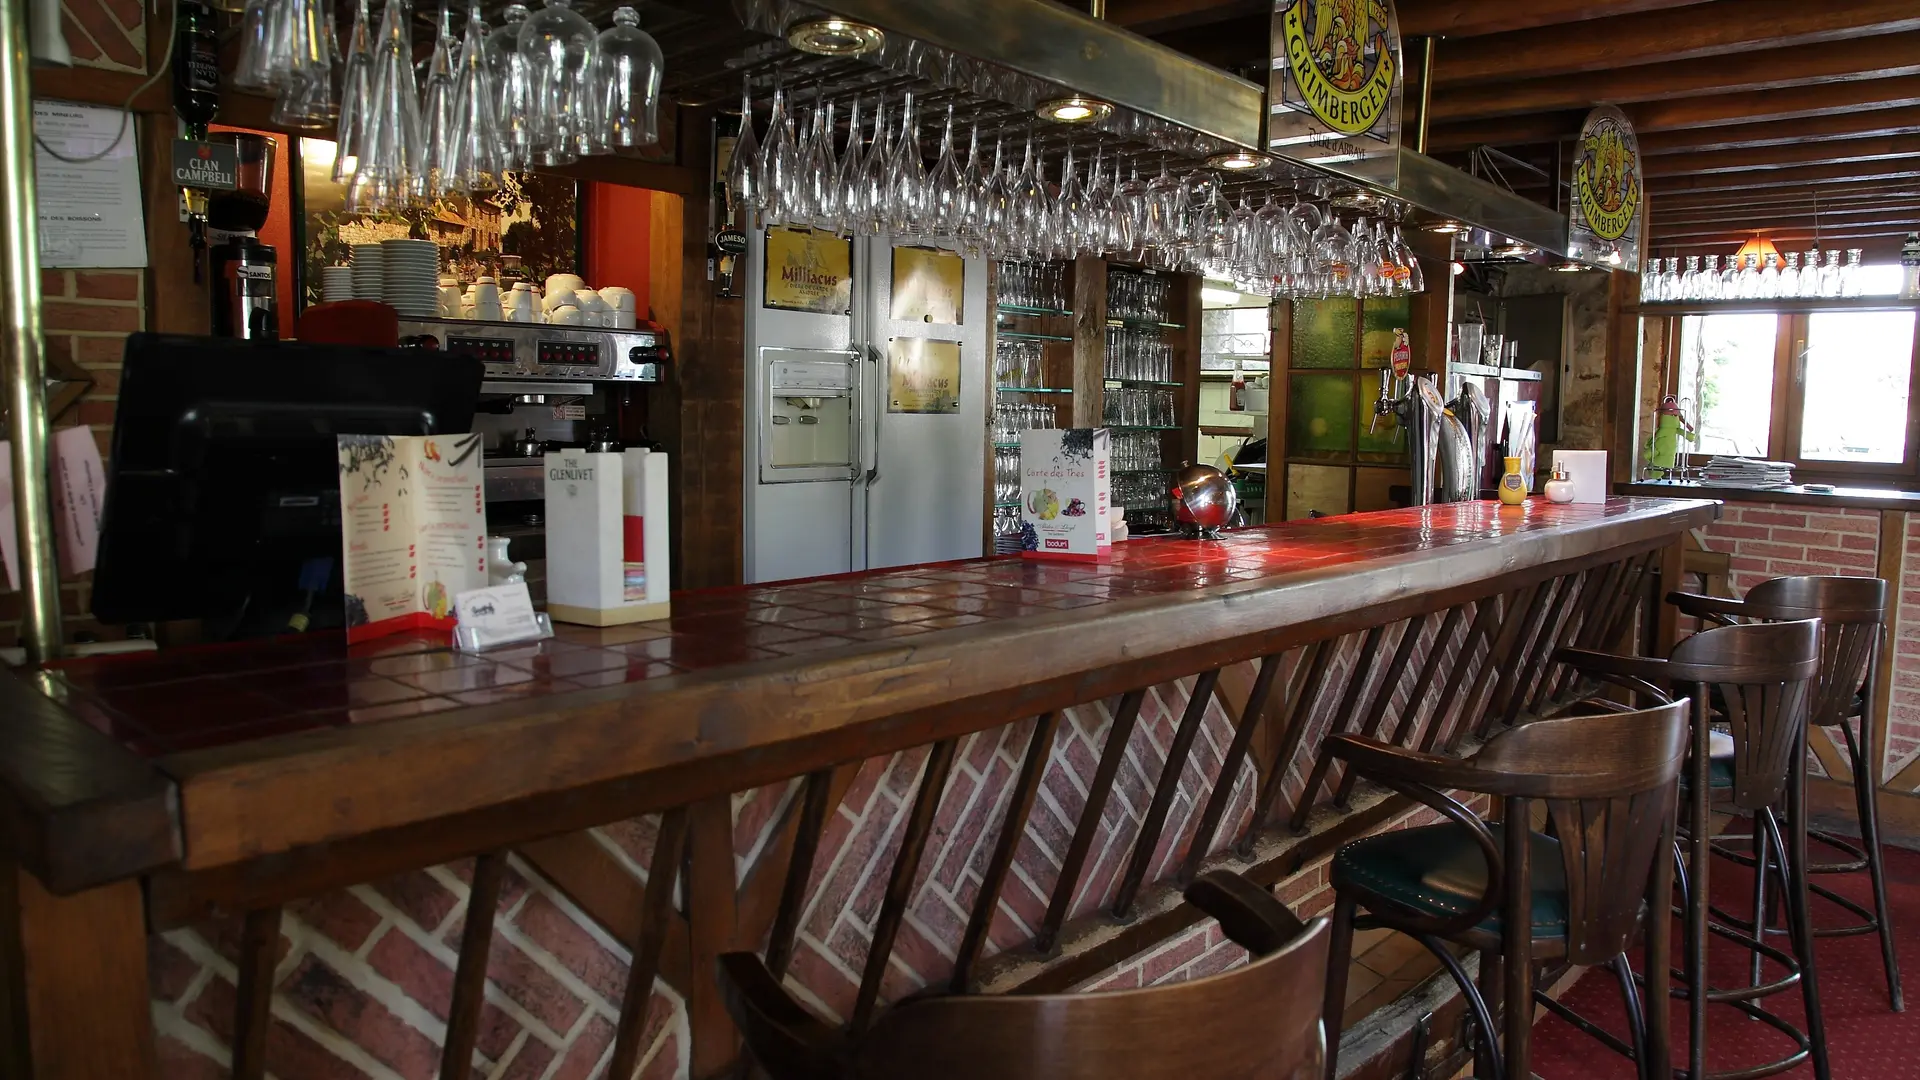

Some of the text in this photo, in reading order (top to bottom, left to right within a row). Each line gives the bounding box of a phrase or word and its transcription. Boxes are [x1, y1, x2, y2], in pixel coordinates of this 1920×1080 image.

[1290, 35, 1388, 124] GRIMBERGEN
[189, 158, 219, 171] CLAN
[176, 168, 233, 185] CAMPBELL
[1581, 181, 1634, 234] GRIMBERGEN
[720, 234, 746, 244] JAMESO
[249, 271, 271, 279] SANTOS
[782, 265, 837, 287] Milliacus
[564, 459, 578, 468] THE
[549, 468, 594, 481] GLENLIVET
[1026, 468, 1048, 477] Carte
[1050, 467, 1064, 477] des
